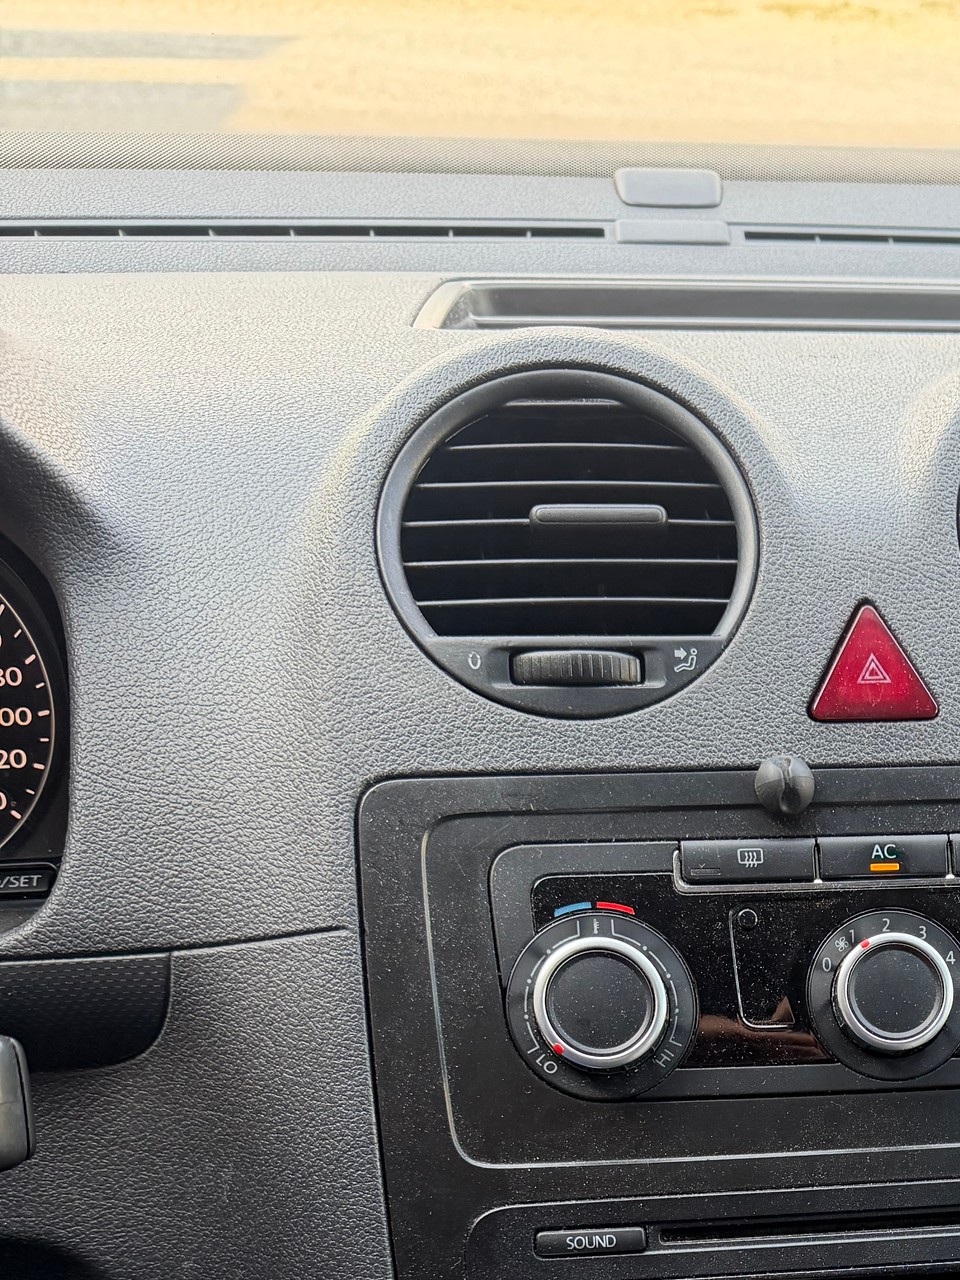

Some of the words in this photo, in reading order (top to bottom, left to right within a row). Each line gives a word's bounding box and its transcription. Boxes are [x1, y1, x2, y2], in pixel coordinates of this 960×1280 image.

[871, 844, 897, 860] AC
[0, 875, 42, 888] /SET
[882, 918, 891, 932] 2
[918, 925, 927, 940] 3
[848, 929, 856, 943] 1
[822, 957, 832, 972] 0
[945, 950, 956, 965] 4
[535, 1054, 558, 1074] LO
[655, 1049, 675, 1068] HI
[566, 1234, 616, 1250] SOUND
